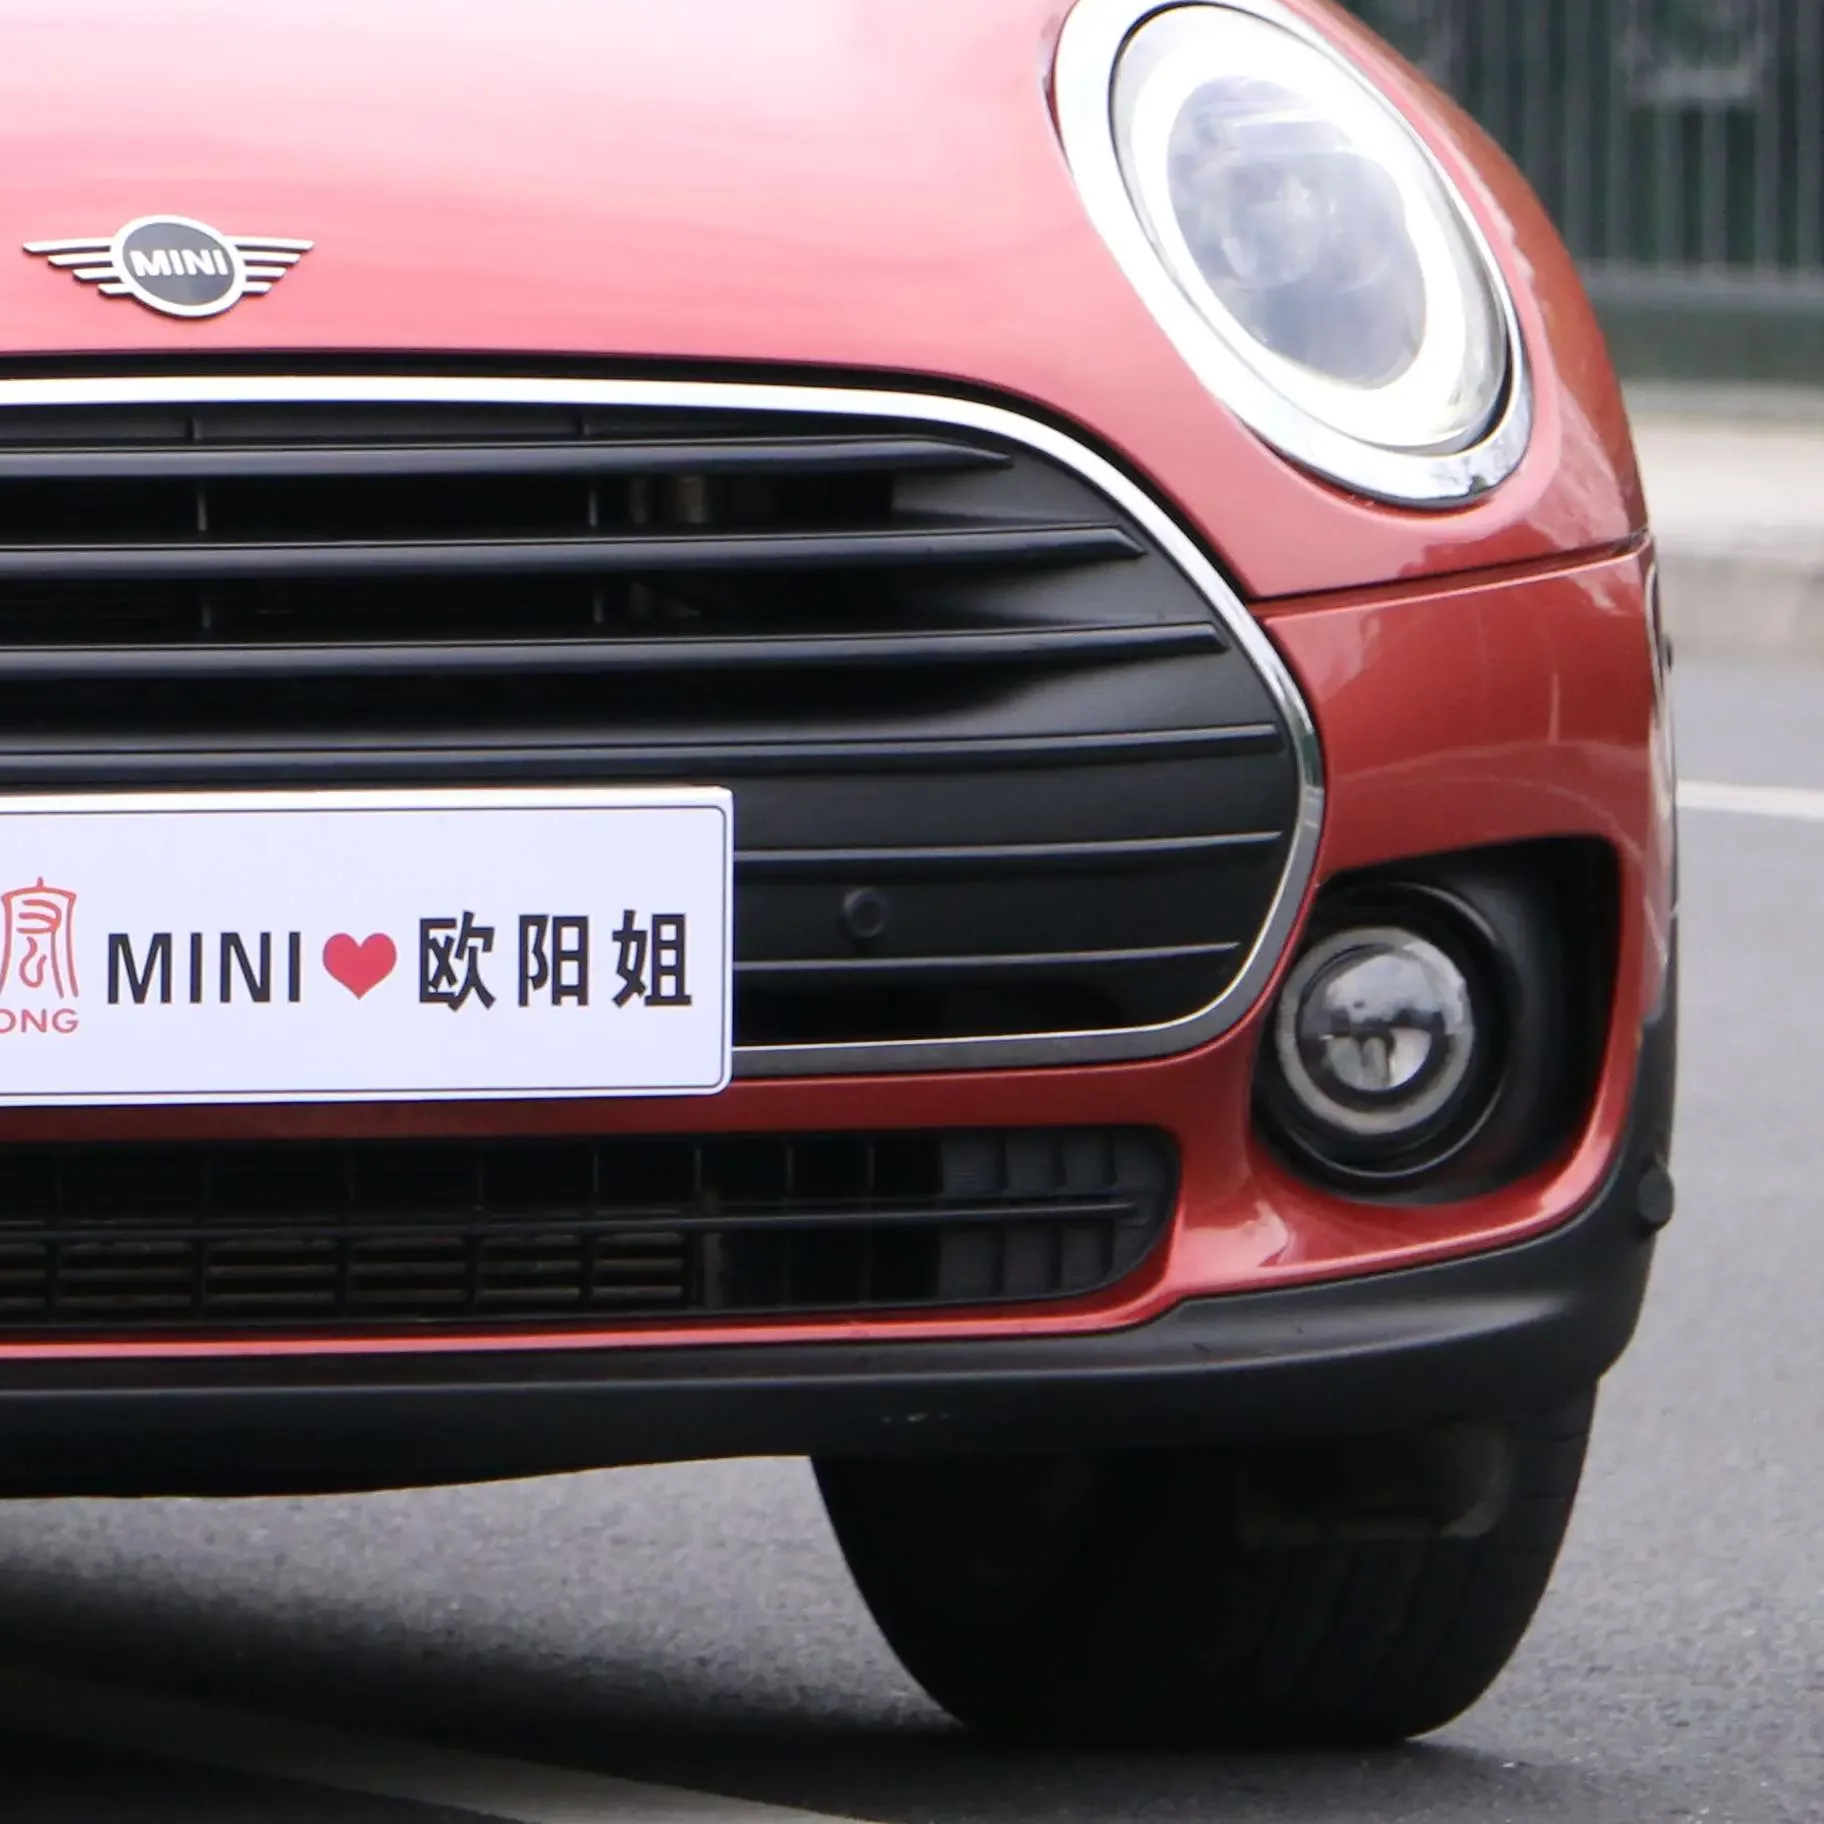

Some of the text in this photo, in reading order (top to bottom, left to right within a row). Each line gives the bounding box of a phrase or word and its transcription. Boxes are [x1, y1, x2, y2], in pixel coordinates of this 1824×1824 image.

[129, 249, 229, 277] MINI
[107, 909, 693, 1012] MINI 欧阳姐
